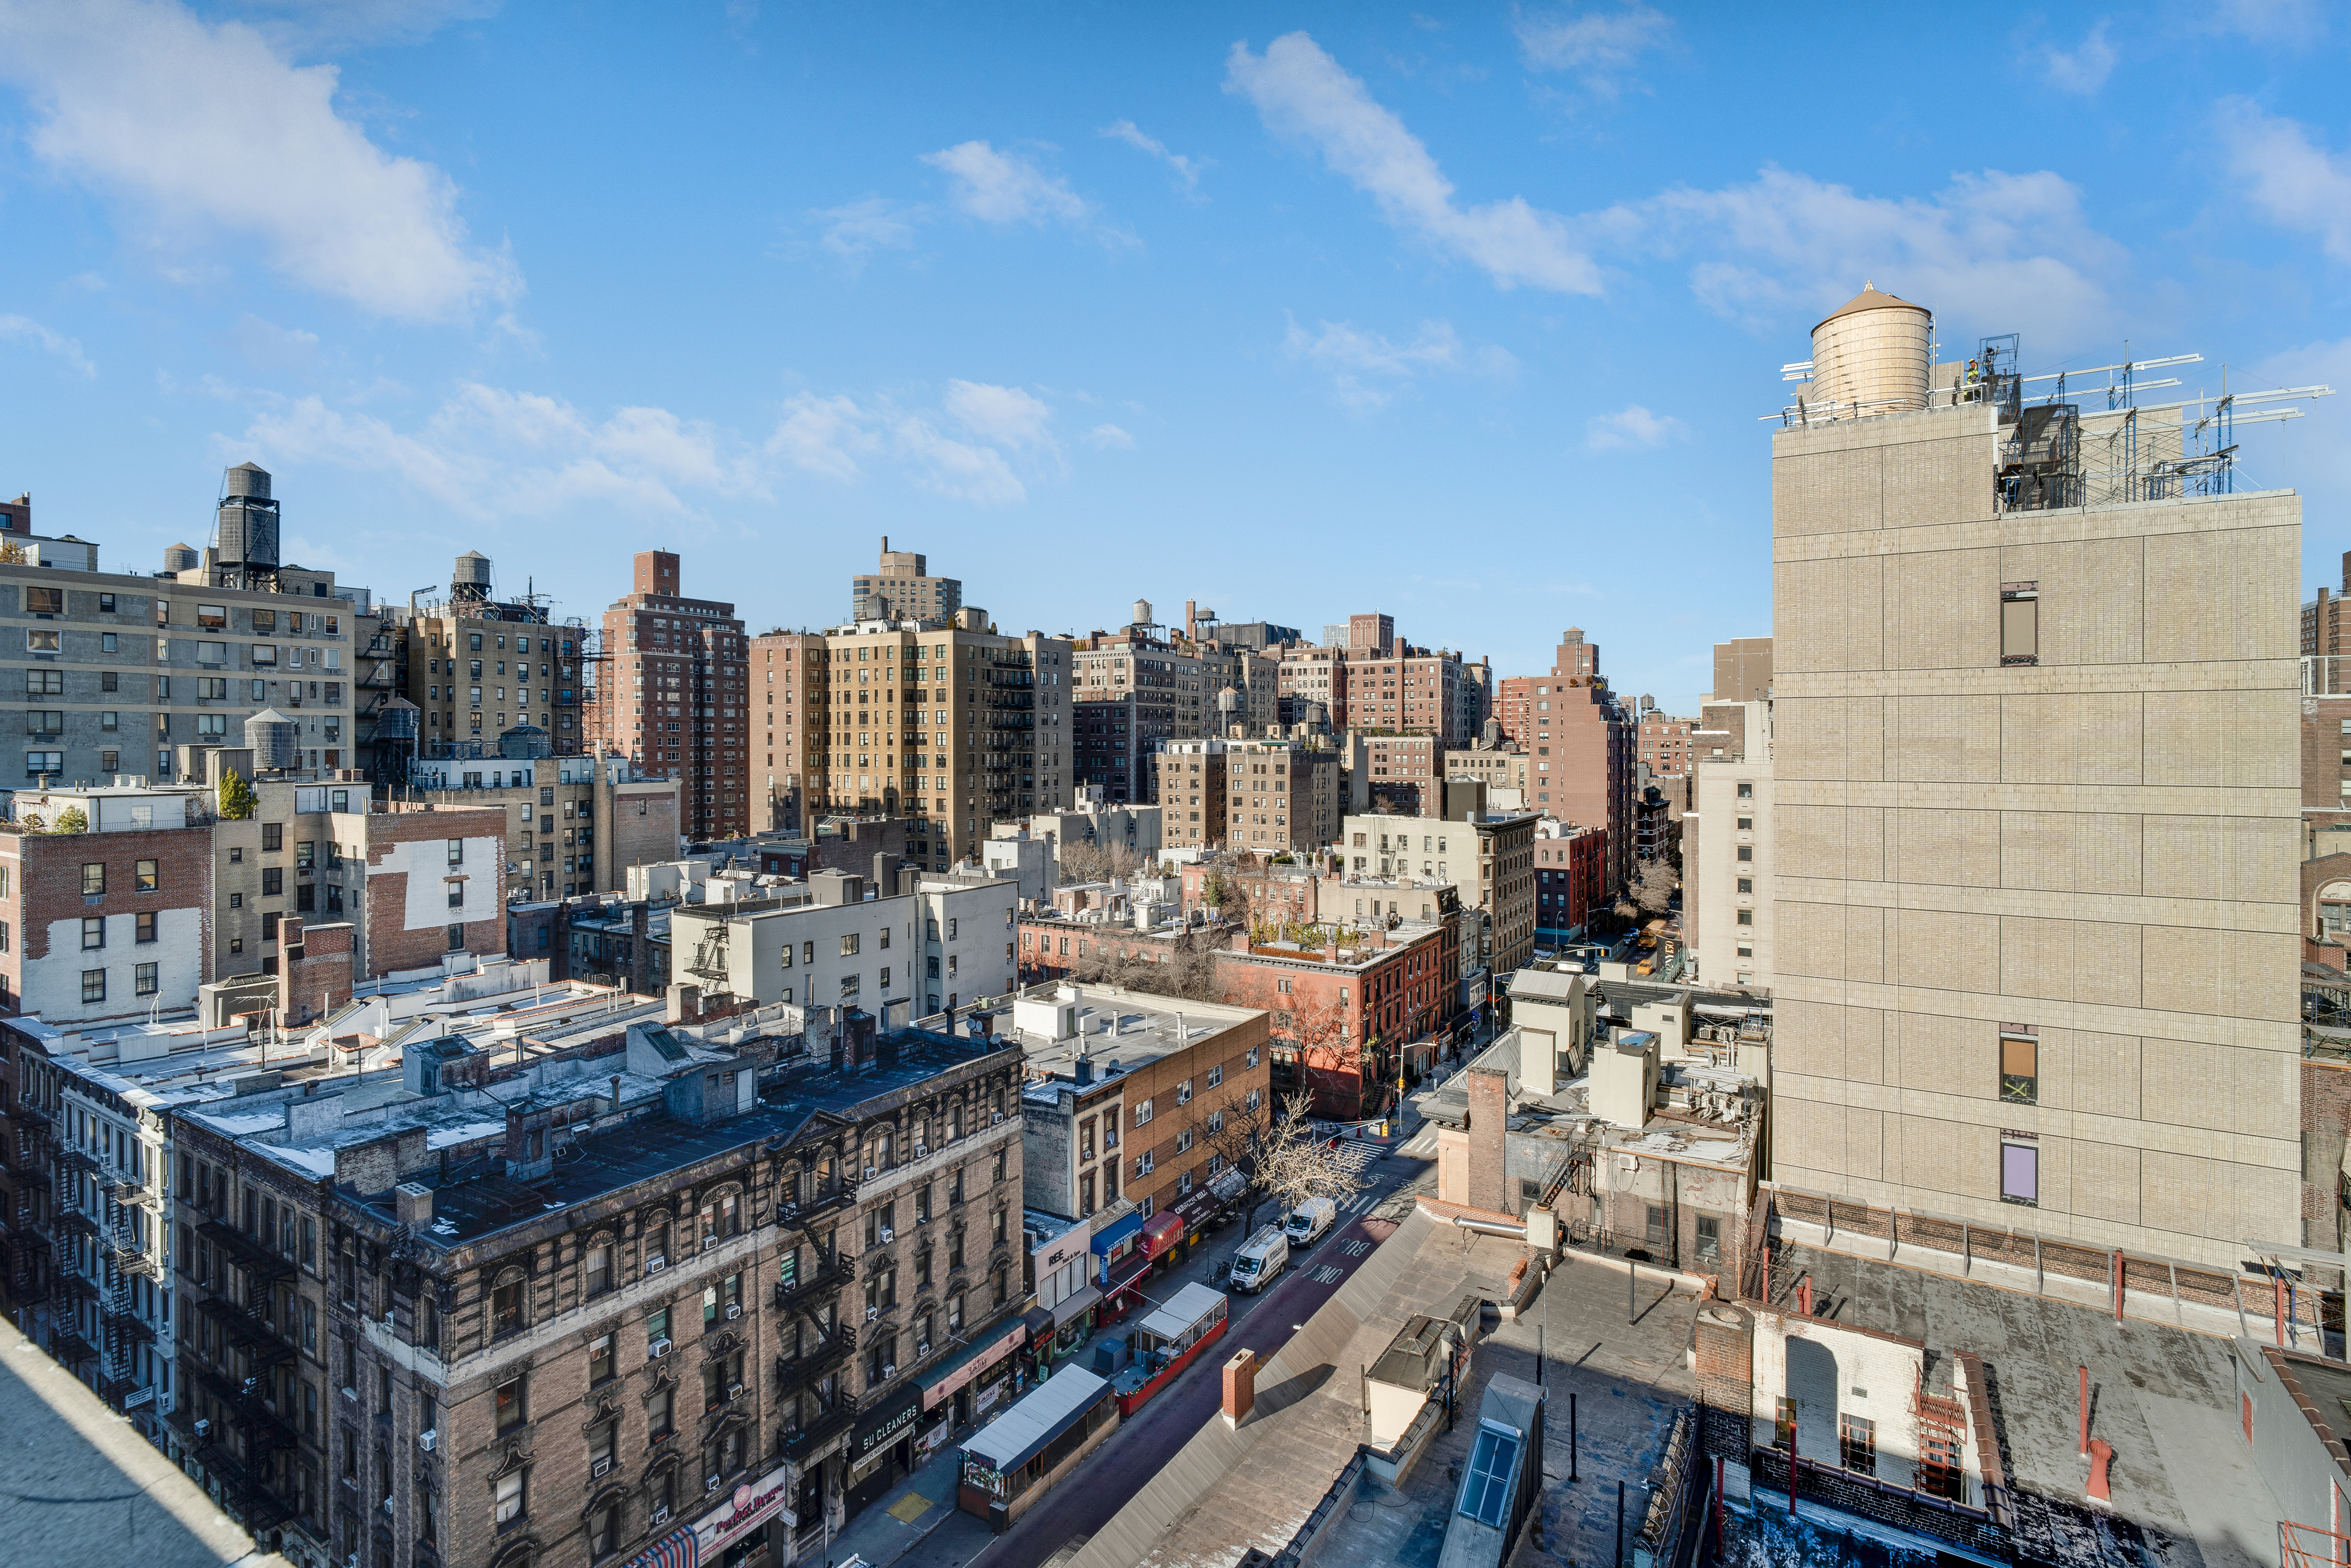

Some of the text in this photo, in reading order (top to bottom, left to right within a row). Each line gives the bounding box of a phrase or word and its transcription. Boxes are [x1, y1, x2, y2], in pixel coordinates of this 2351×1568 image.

[1108, 1242, 1120, 1253] PILATES
[1124, 1228, 1142, 1242] GYROTONIC
[1049, 1249, 1064, 1267] REE
[1034, 1338, 1045, 1351] SMOKE
[1045, 1330, 1054, 1341] SHOP
[968, 1357, 987, 1376] LOLITAS
[977, 1388, 995, 1406] LOLITAS
[863, 1405, 917, 1450] SU CLEANERS
[855, 1454, 874, 1469] UNDER
[874, 1443, 886, 1455] NEW
[716, 1502, 753, 1534] Perfect
[753, 1483, 784, 1509] Brows
[718, 1534, 733, 1545] WAXING
[735, 1524, 748, 1534] FACIAL
[749, 1511, 765, 1524] EYELASH
[765, 1498, 783, 1513] EXTENTION
[701, 1556, 709, 1564] 1364
